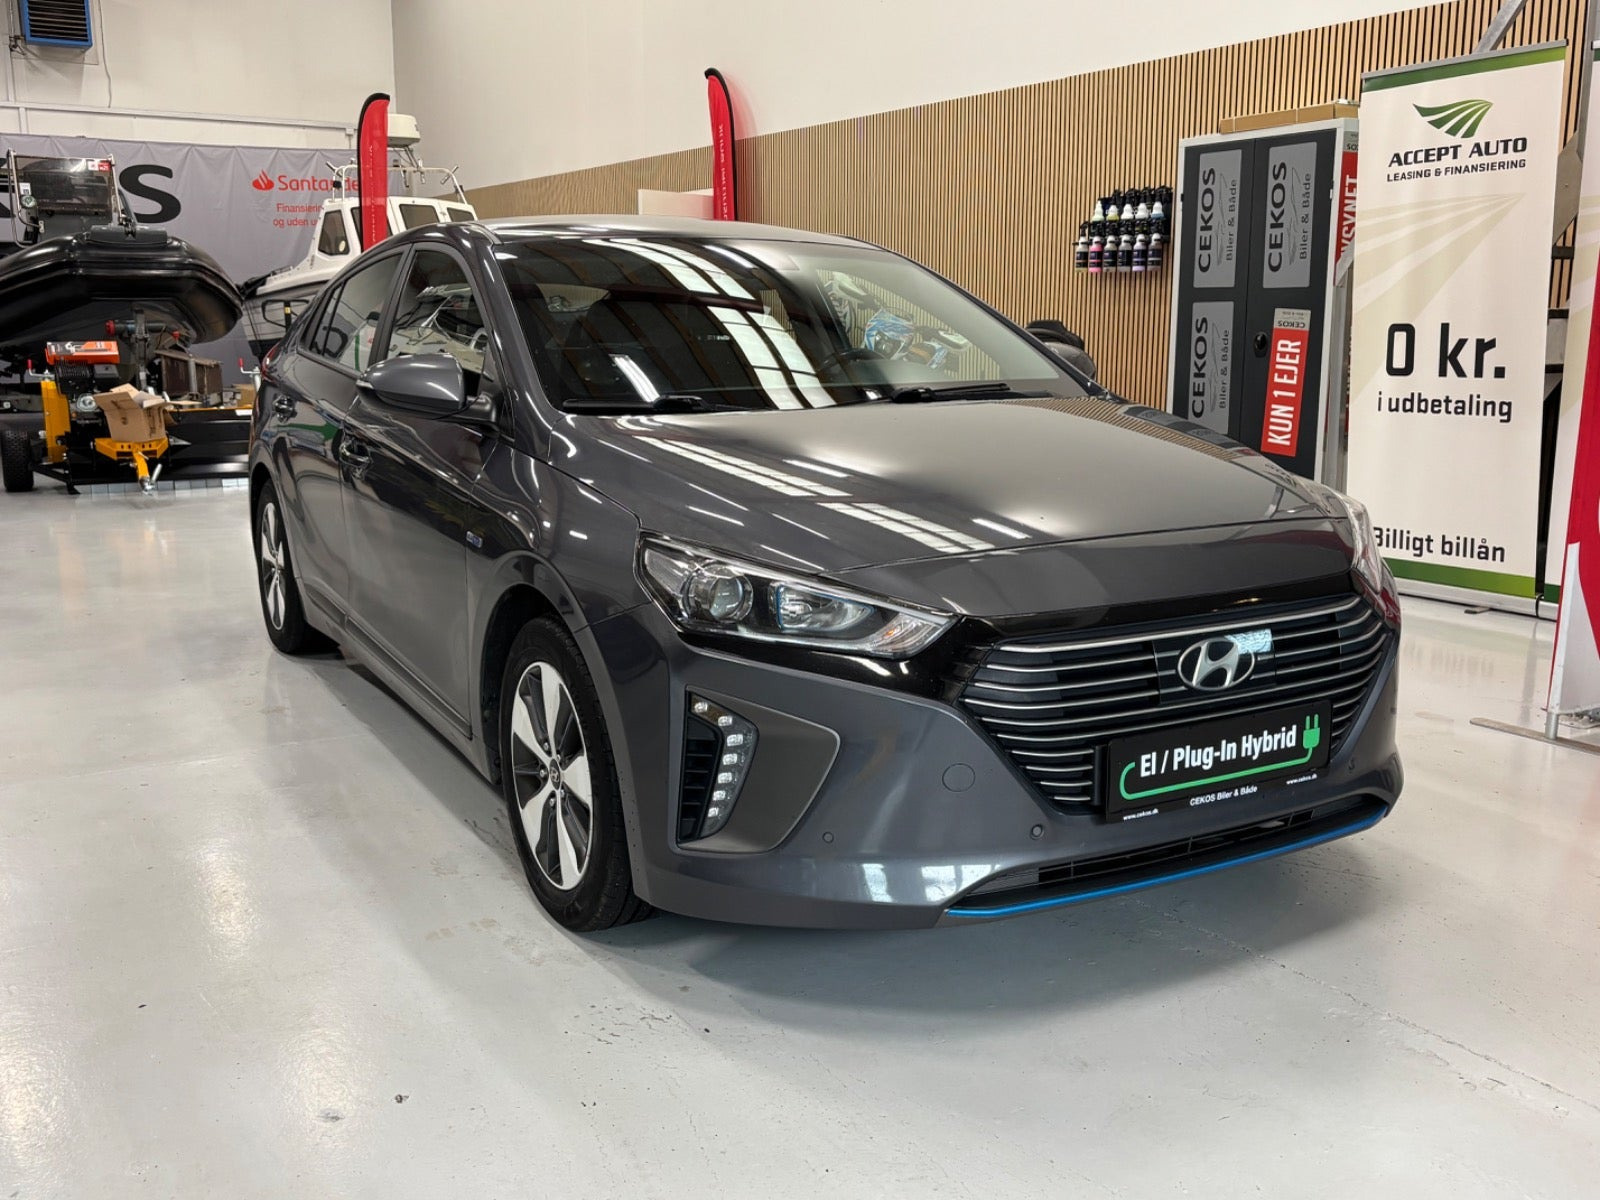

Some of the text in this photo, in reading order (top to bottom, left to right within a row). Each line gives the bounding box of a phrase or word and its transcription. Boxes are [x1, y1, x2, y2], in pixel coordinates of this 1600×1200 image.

[1386, 158, 1527, 182] LEASING & FINANSIERING
[1388, 137, 1528, 168] ACCEPT AUTO
[273, 218, 285, 229] og
[1198, 167, 1216, 273] CEKOS
[1267, 161, 1287, 273] CEKOS
[1299, 173, 1312, 260] Biler & Både
[1192, 317, 1208, 418] CEKOS
[1273, 339, 1302, 385] EJER
[1386, 323, 1506, 379] 0 kr.
[1272, 390, 1296, 398] 1
[1377, 391, 1513, 423] i udbetaling
[1267, 403, 1295, 446] KUN
[1373, 526, 1506, 563] Billigt billån
[1140, 724, 1298, 778] El / Plug-In Hybrid
[1189, 785, 1258, 807] CEKOS Biler & Både
